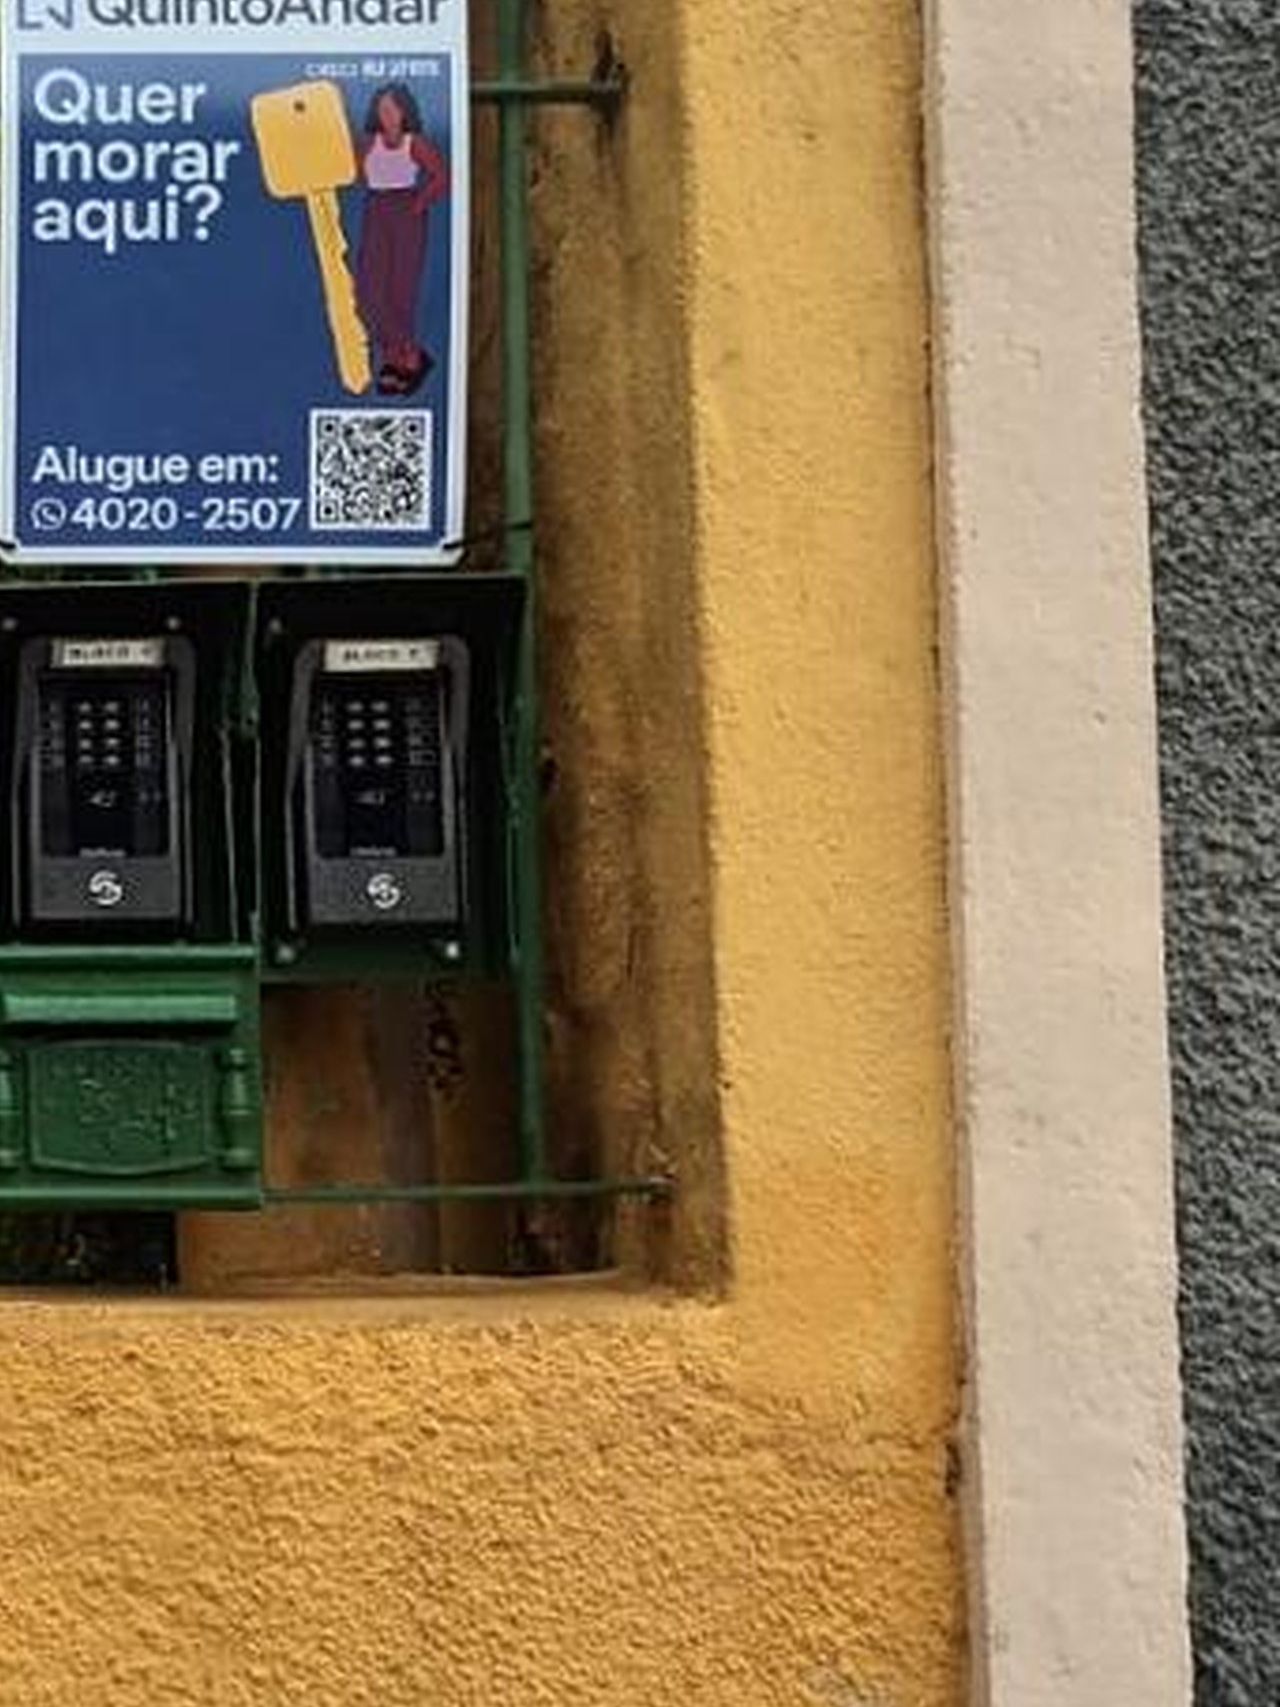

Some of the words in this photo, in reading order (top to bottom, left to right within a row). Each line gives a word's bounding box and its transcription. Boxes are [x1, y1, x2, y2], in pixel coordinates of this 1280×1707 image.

[32, 68, 206, 125] Quer
[31, 138, 240, 183] morar
[31, 182, 224, 252] aqui?
[31, 445, 191, 493] Alugue
[197, 454, 280, 483] em:
